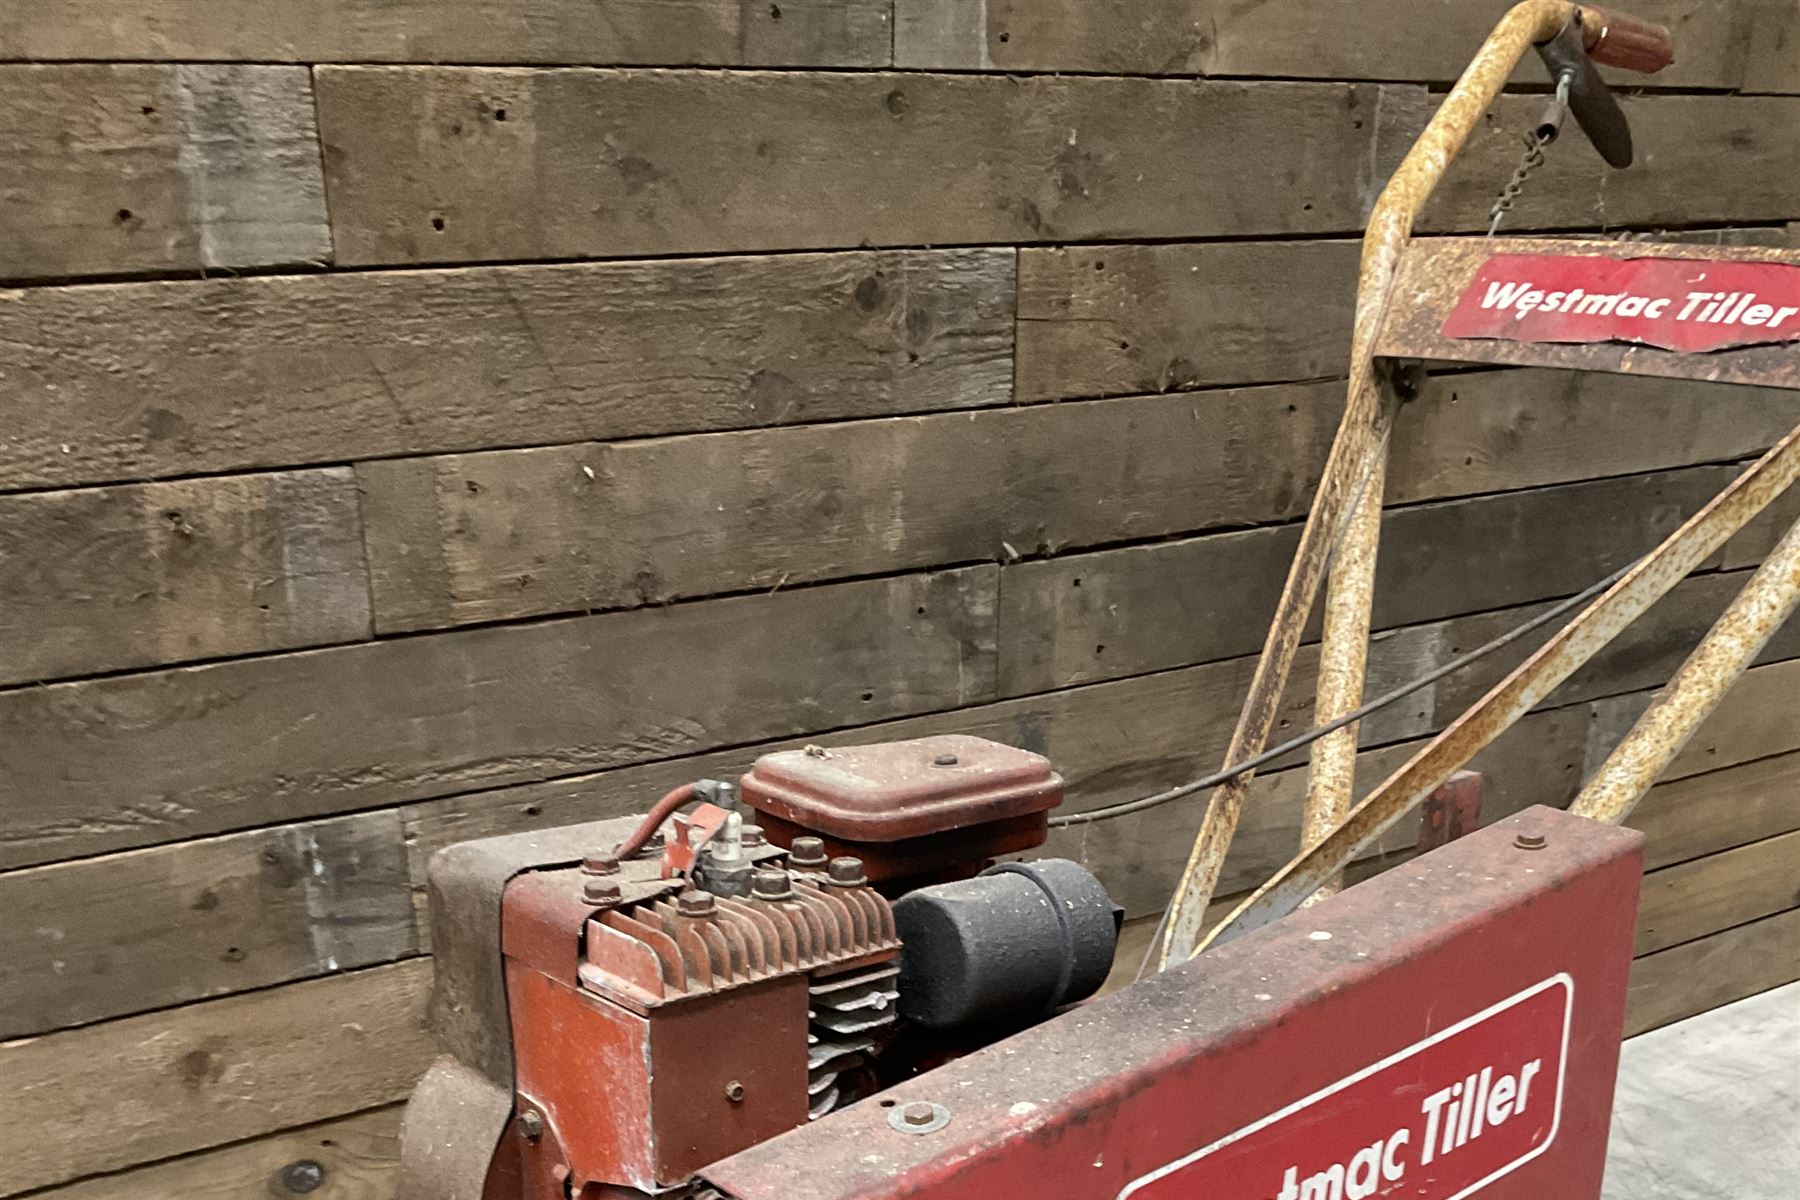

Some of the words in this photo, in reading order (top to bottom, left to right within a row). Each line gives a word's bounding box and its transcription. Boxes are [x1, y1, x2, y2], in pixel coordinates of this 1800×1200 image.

[1480, 282, 1671, 319] Westmac
[1676, 291, 1799, 328] Tiller
[1421, 1058, 1541, 1167] Tiller
